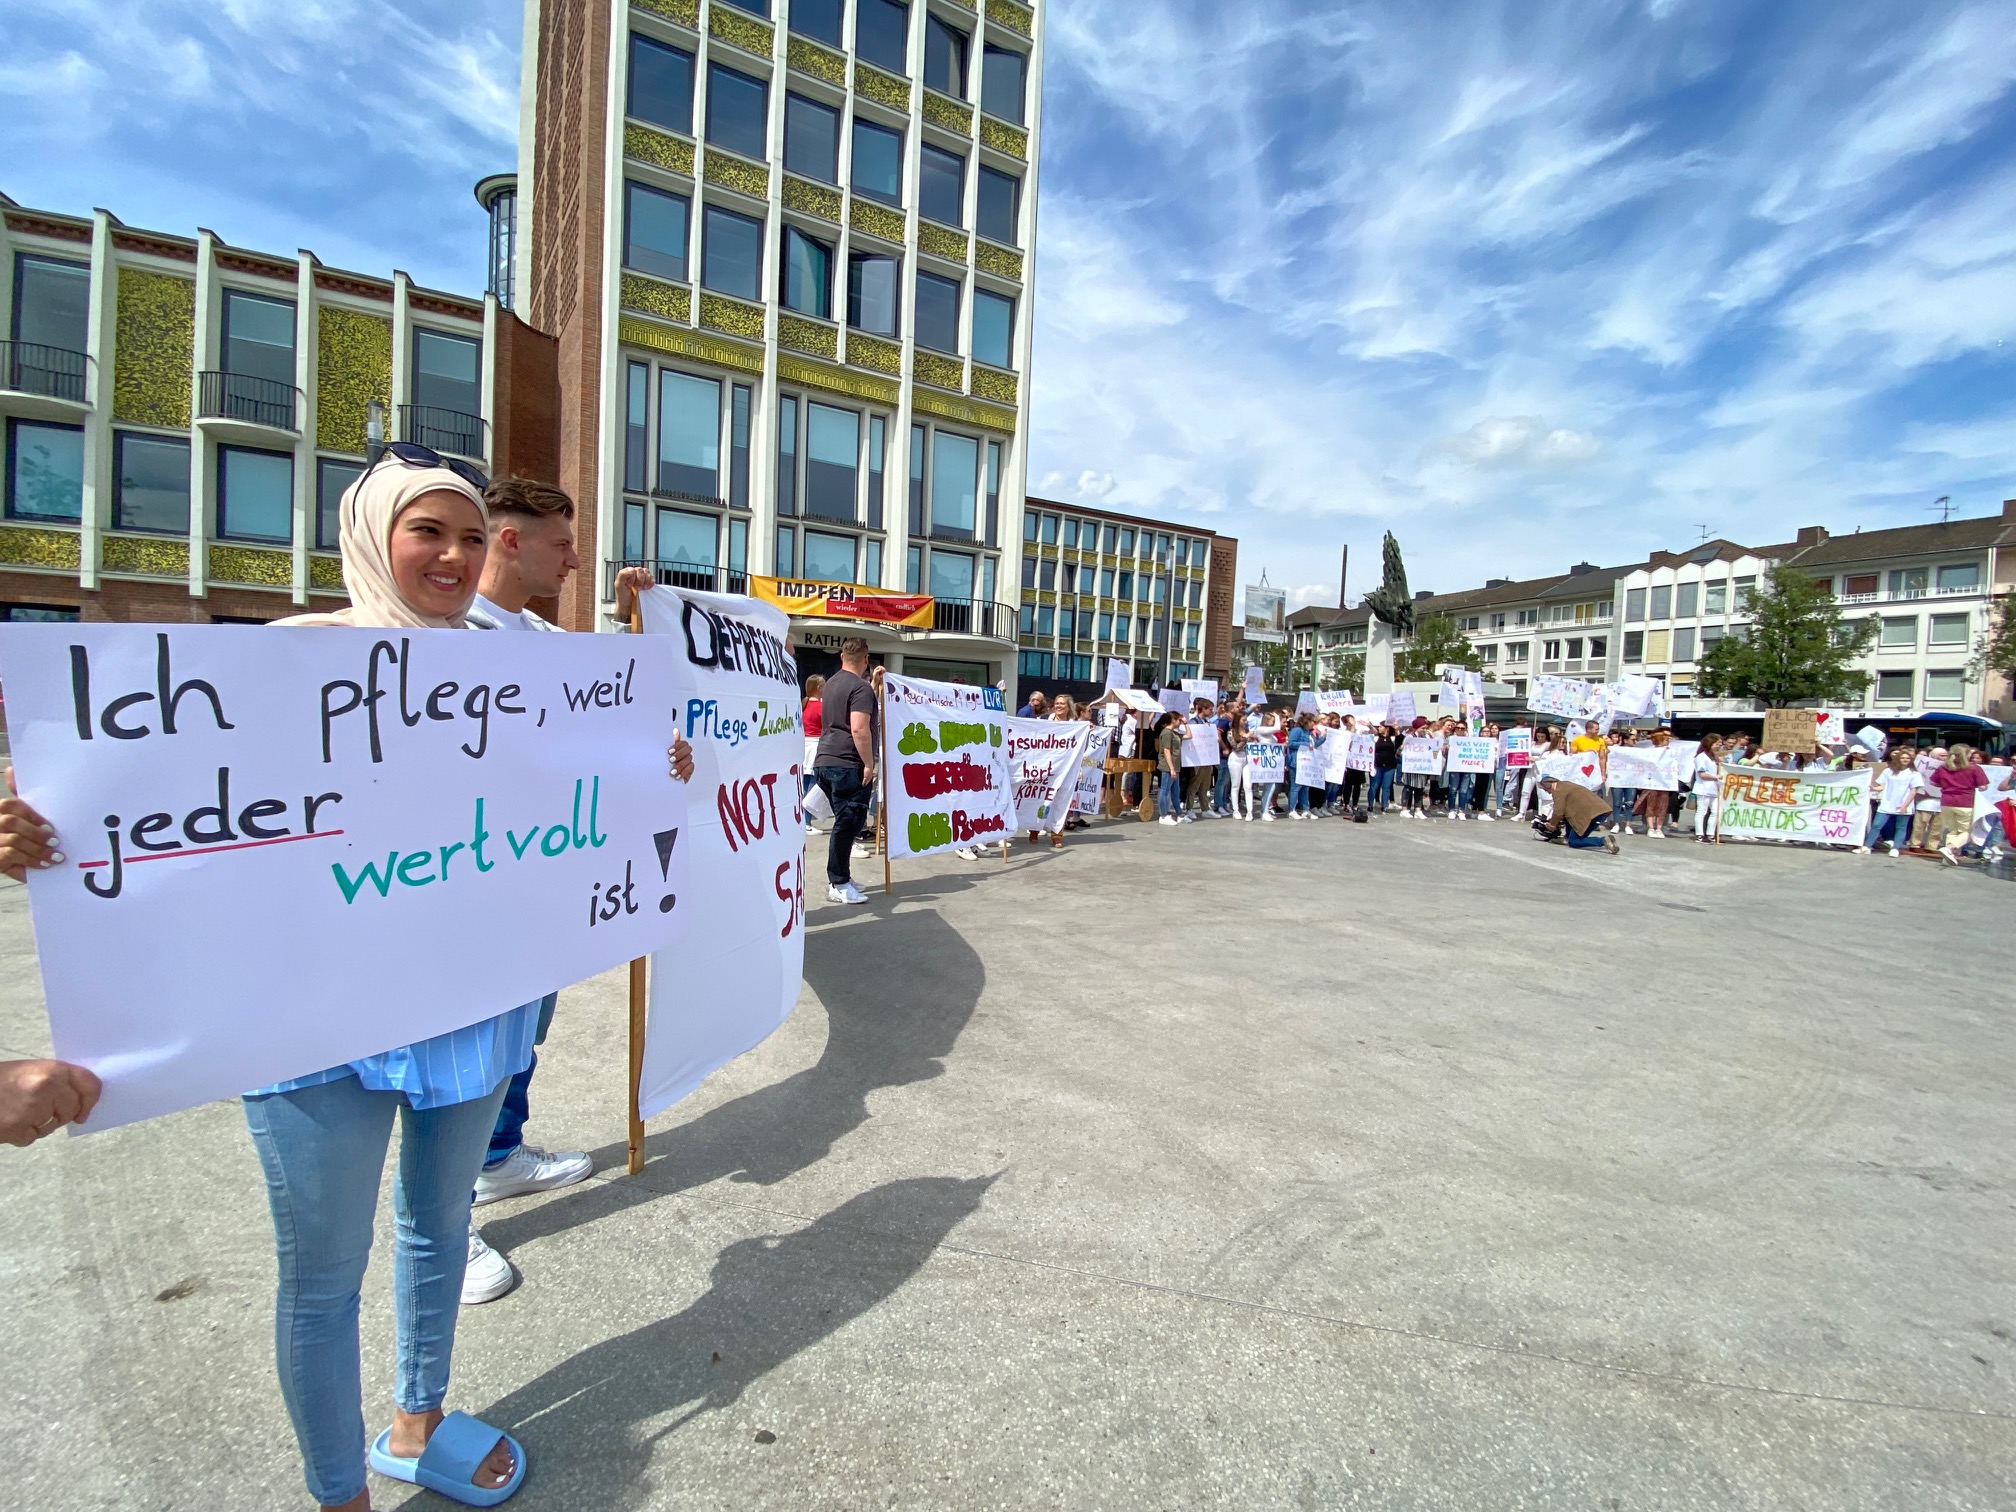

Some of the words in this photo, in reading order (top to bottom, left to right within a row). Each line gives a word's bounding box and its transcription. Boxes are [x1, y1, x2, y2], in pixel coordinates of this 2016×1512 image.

[776, 582, 855, 603] IMPFEN
[836, 604, 858, 613] wieder
[805, 633, 849, 648] RATHA
[70, 633, 235, 740] Ich
[321, 637, 547, 763] pflege,
[563, 658, 636, 713] weil
[983, 689, 1001, 709] LVR
[1244, 744, 1268, 757] MEHR
[1023, 761, 1055, 778] hört
[1261, 756, 1278, 769] UNS
[1014, 783, 1055, 802] KÖRPE
[1723, 773, 1801, 805] PFLEGE
[1829, 785, 1860, 806] WIR
[717, 773, 780, 853] NOT
[1720, 803, 1774, 830] KÖNNEN
[1775, 808, 1808, 832] DAS
[1819, 808, 1853, 824] EGAL
[83, 766, 344, 899] jeder
[1823, 825, 1850, 838] WO
